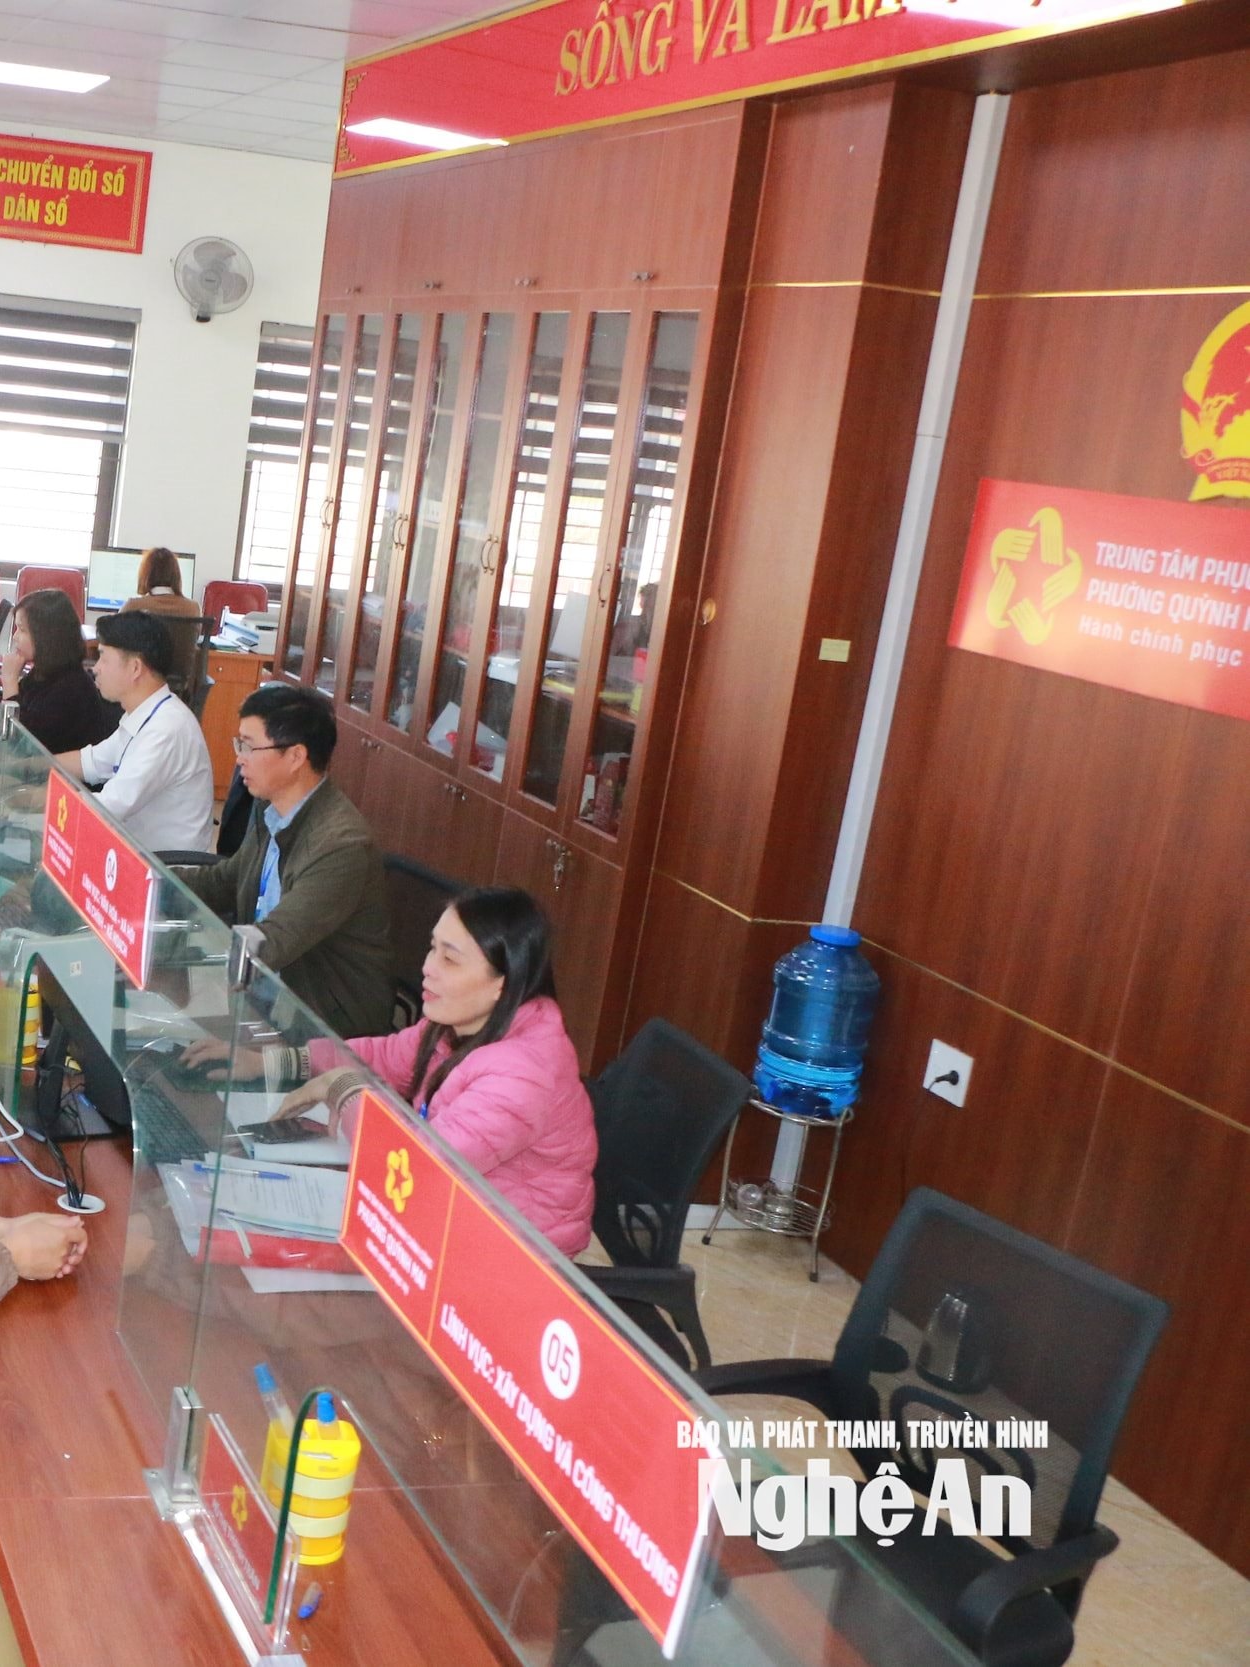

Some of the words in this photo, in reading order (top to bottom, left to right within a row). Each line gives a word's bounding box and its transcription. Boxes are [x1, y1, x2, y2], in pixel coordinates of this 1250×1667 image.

[68, 160, 97, 196] ĐỔI
[102, 164, 128, 197] SỐ
[3, 192, 39, 224] DÂN
[44, 195, 70, 227] SỐ
[1096, 541, 1157, 574] TRUNG
[1201, 557, 1250, 594] PHỤ
[1189, 639, 1243, 668] phục
[547, 1332, 574, 1387] 05
[440, 1303, 469, 1352] LĨNH
[493, 1365, 521, 1409] XÂY
[572, 1458, 615, 1523] CÔNG
